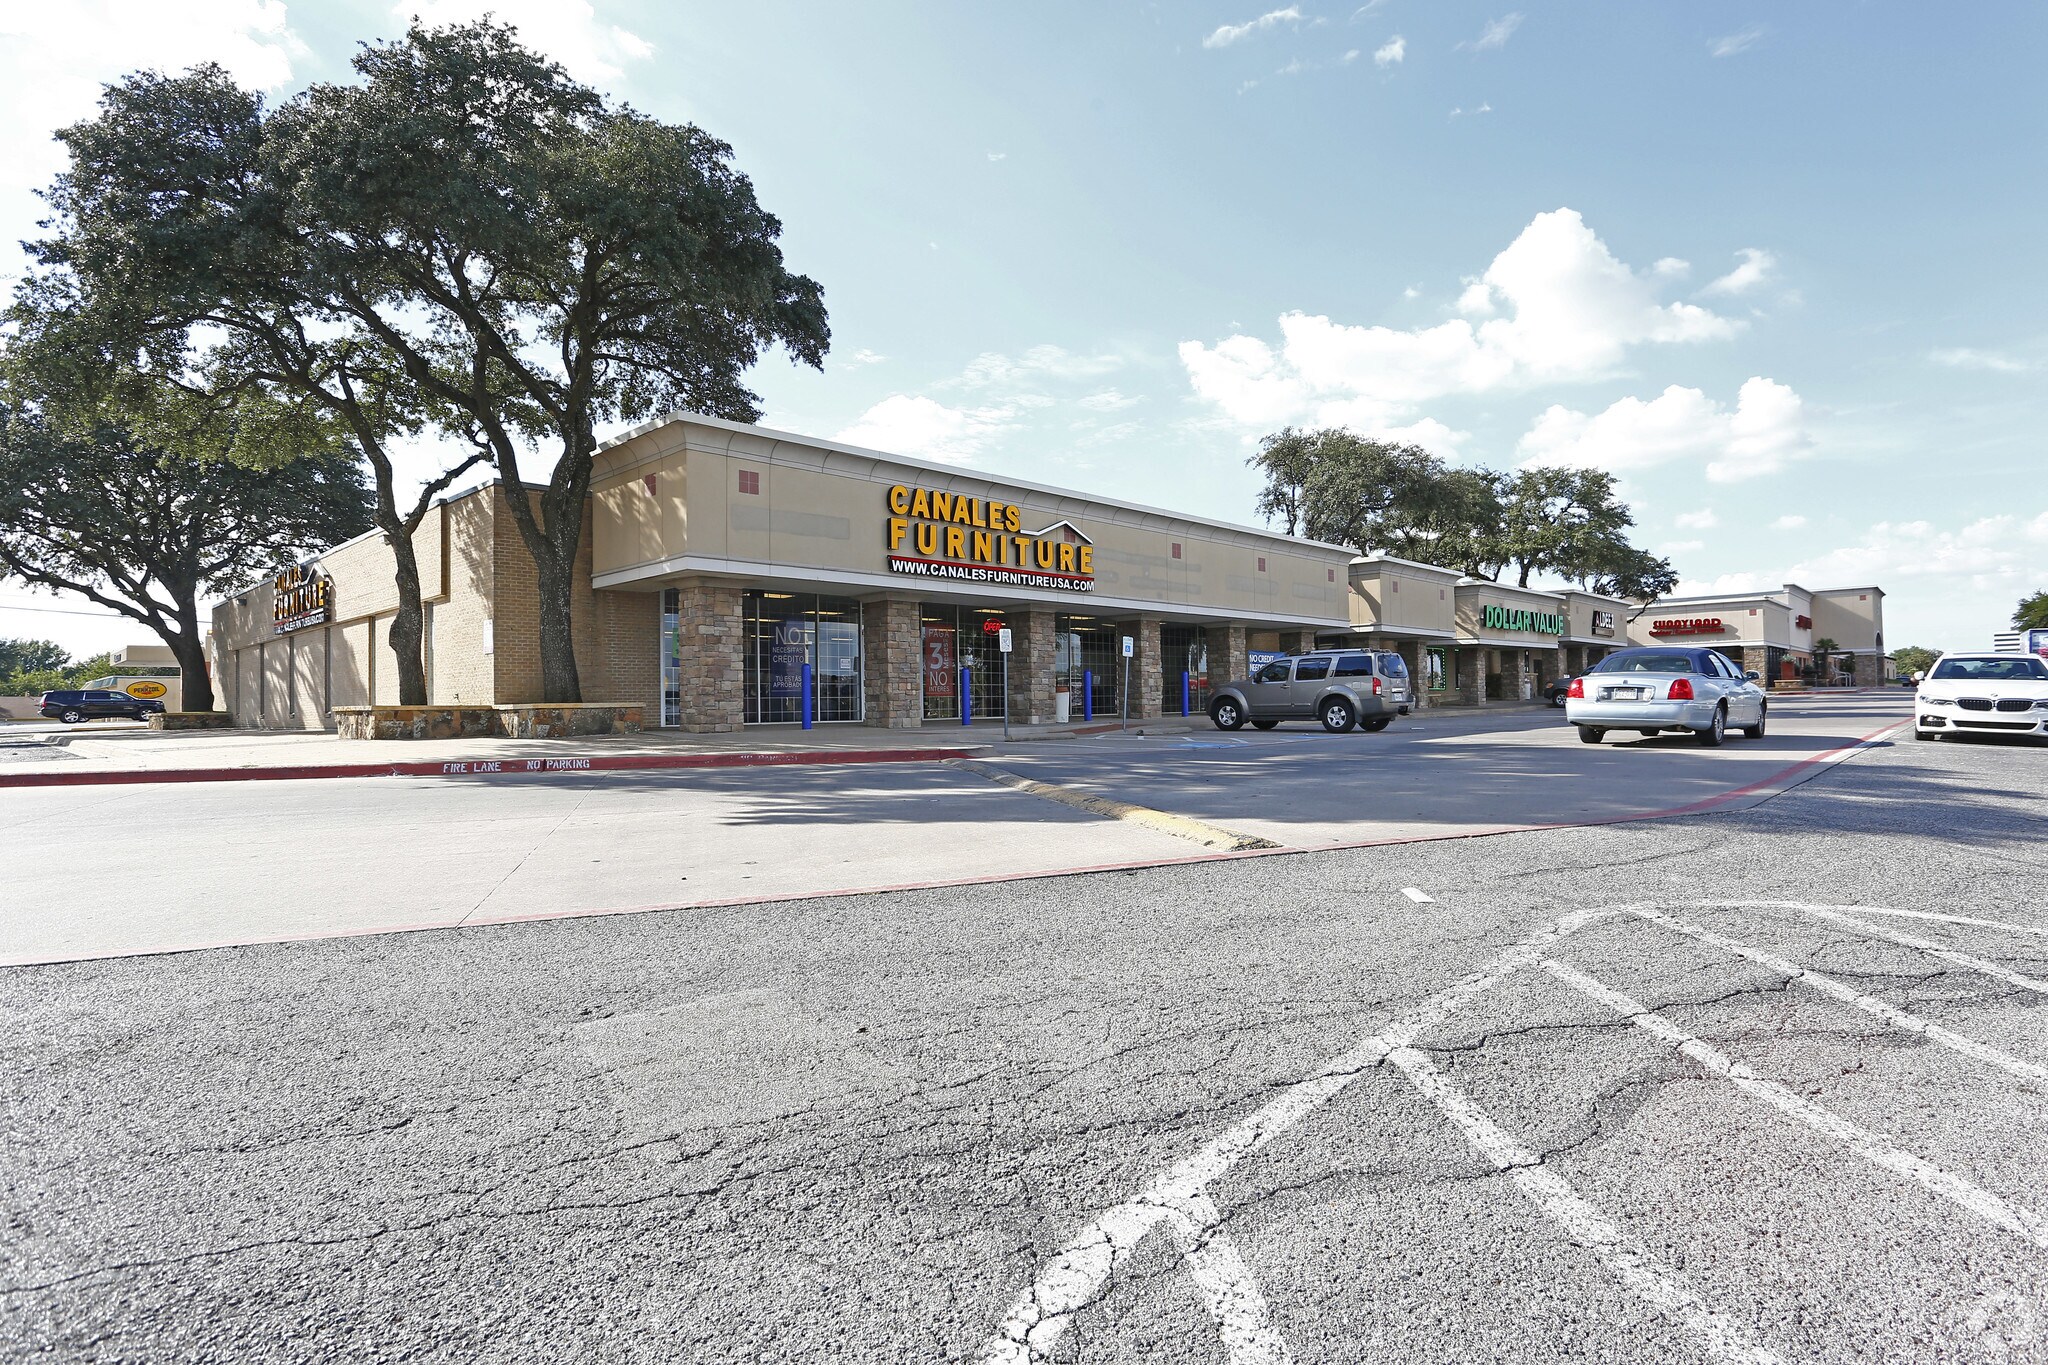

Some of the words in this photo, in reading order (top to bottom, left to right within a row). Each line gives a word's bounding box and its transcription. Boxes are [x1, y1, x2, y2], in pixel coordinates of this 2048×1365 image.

[889, 485, 1021, 533] CANALES
[888, 517, 1094, 574] FURNITURE
[891, 559, 1095, 592] WWW.CANALESFURNITUREUSA.COM
[984, 621, 1001, 631] OPEN
[1485, 605, 1531, 632] DOLLAR
[1532, 611, 1564, 635] VALUE
[775, 626, 801, 645] NO
[928, 628, 950, 638] PAGA
[772, 646, 804, 654] NECESITAS
[929, 642, 943, 670] 3
[772, 654, 805, 663] CRÉDITO
[1249, 654, 1258, 663] NO
[1258, 655, 1274, 663] CREDIT
[930, 671, 948, 686] NO
[443, 763, 468, 773] FIRE
[473, 761, 502, 773] LANE
[526, 760, 541, 770] NO
[546, 759, 590, 769] PARKING
